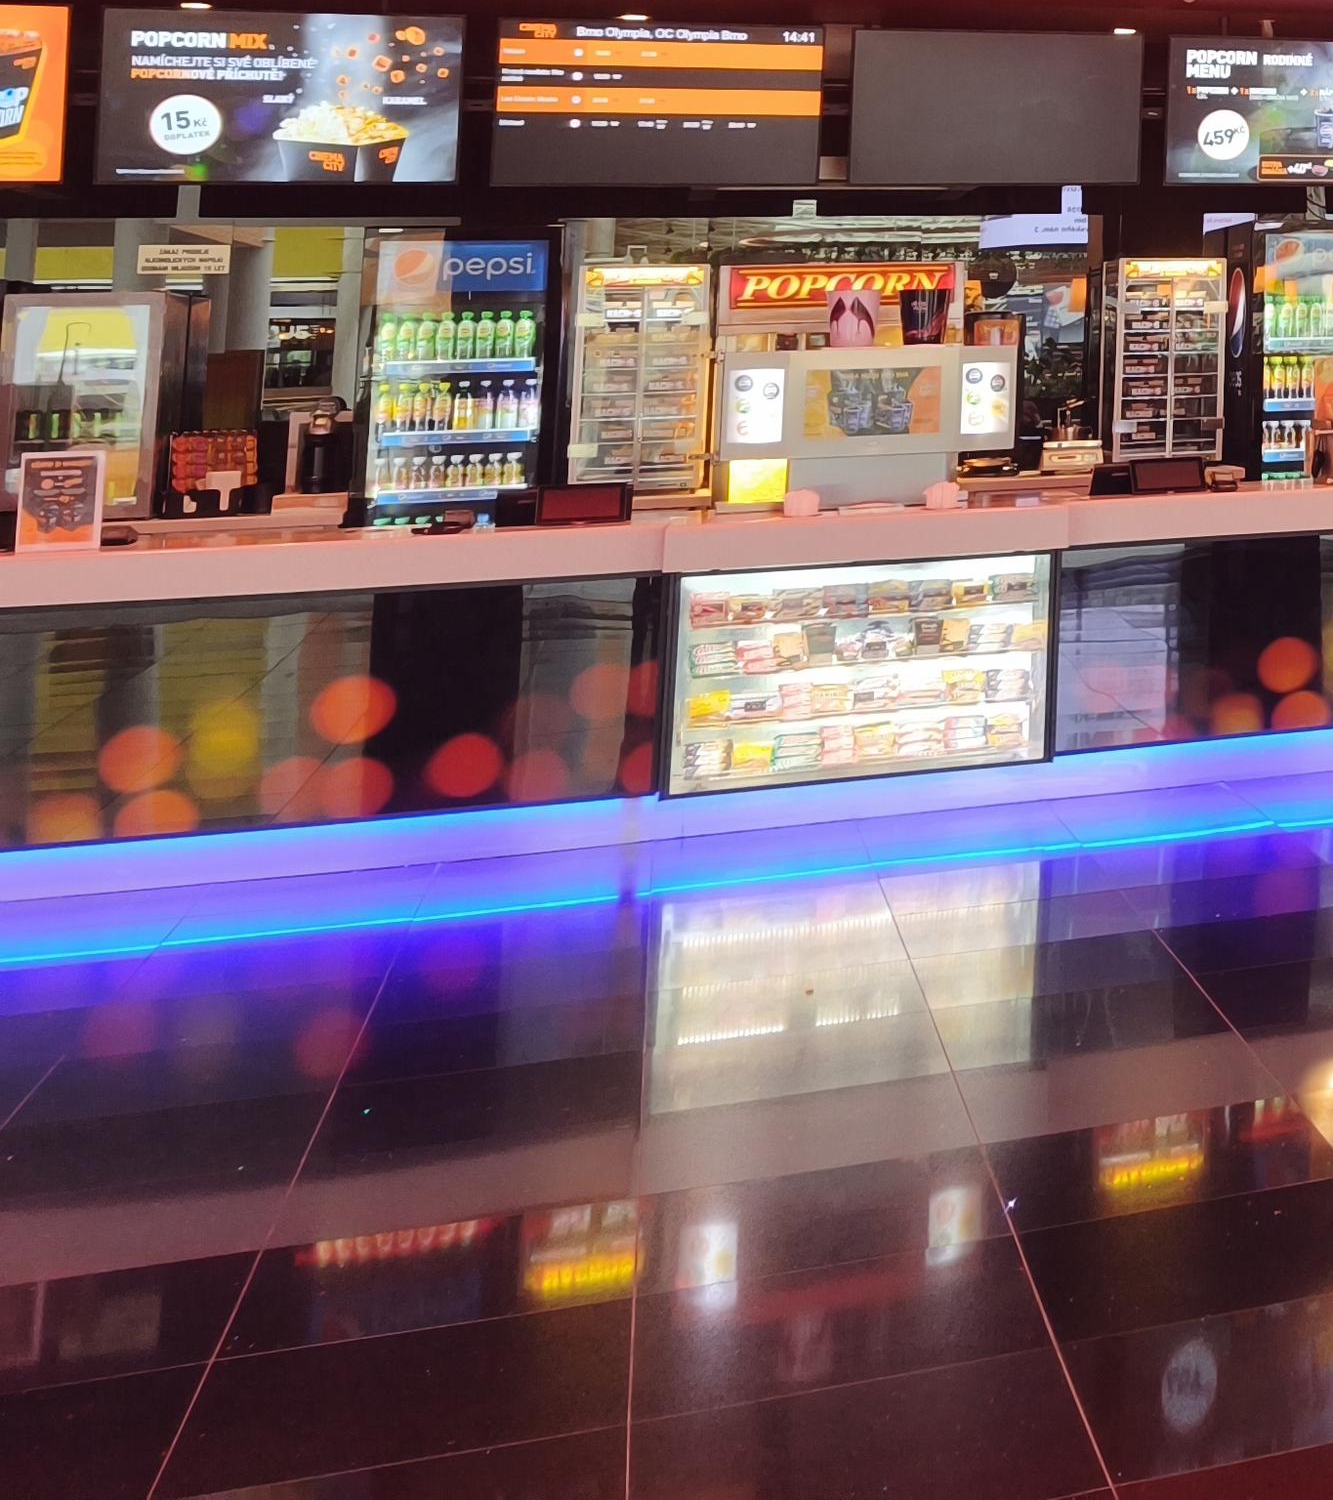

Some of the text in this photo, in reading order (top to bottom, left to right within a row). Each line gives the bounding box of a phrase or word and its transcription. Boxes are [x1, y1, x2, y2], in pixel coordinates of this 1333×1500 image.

[131, 31, 268, 49] POPCORN MIX
[655, 29, 674, 39] OC
[782, 31, 816, 43] 14:41
[1186, 49, 1257, 66] POPCORN
[1186, 63, 1231, 79] MENU
[161, 110, 191, 131] 15
[1203, 128, 1234, 147] 459
[443, 252, 535, 280] pepsi
[737, 272, 947, 300] POPCORN
